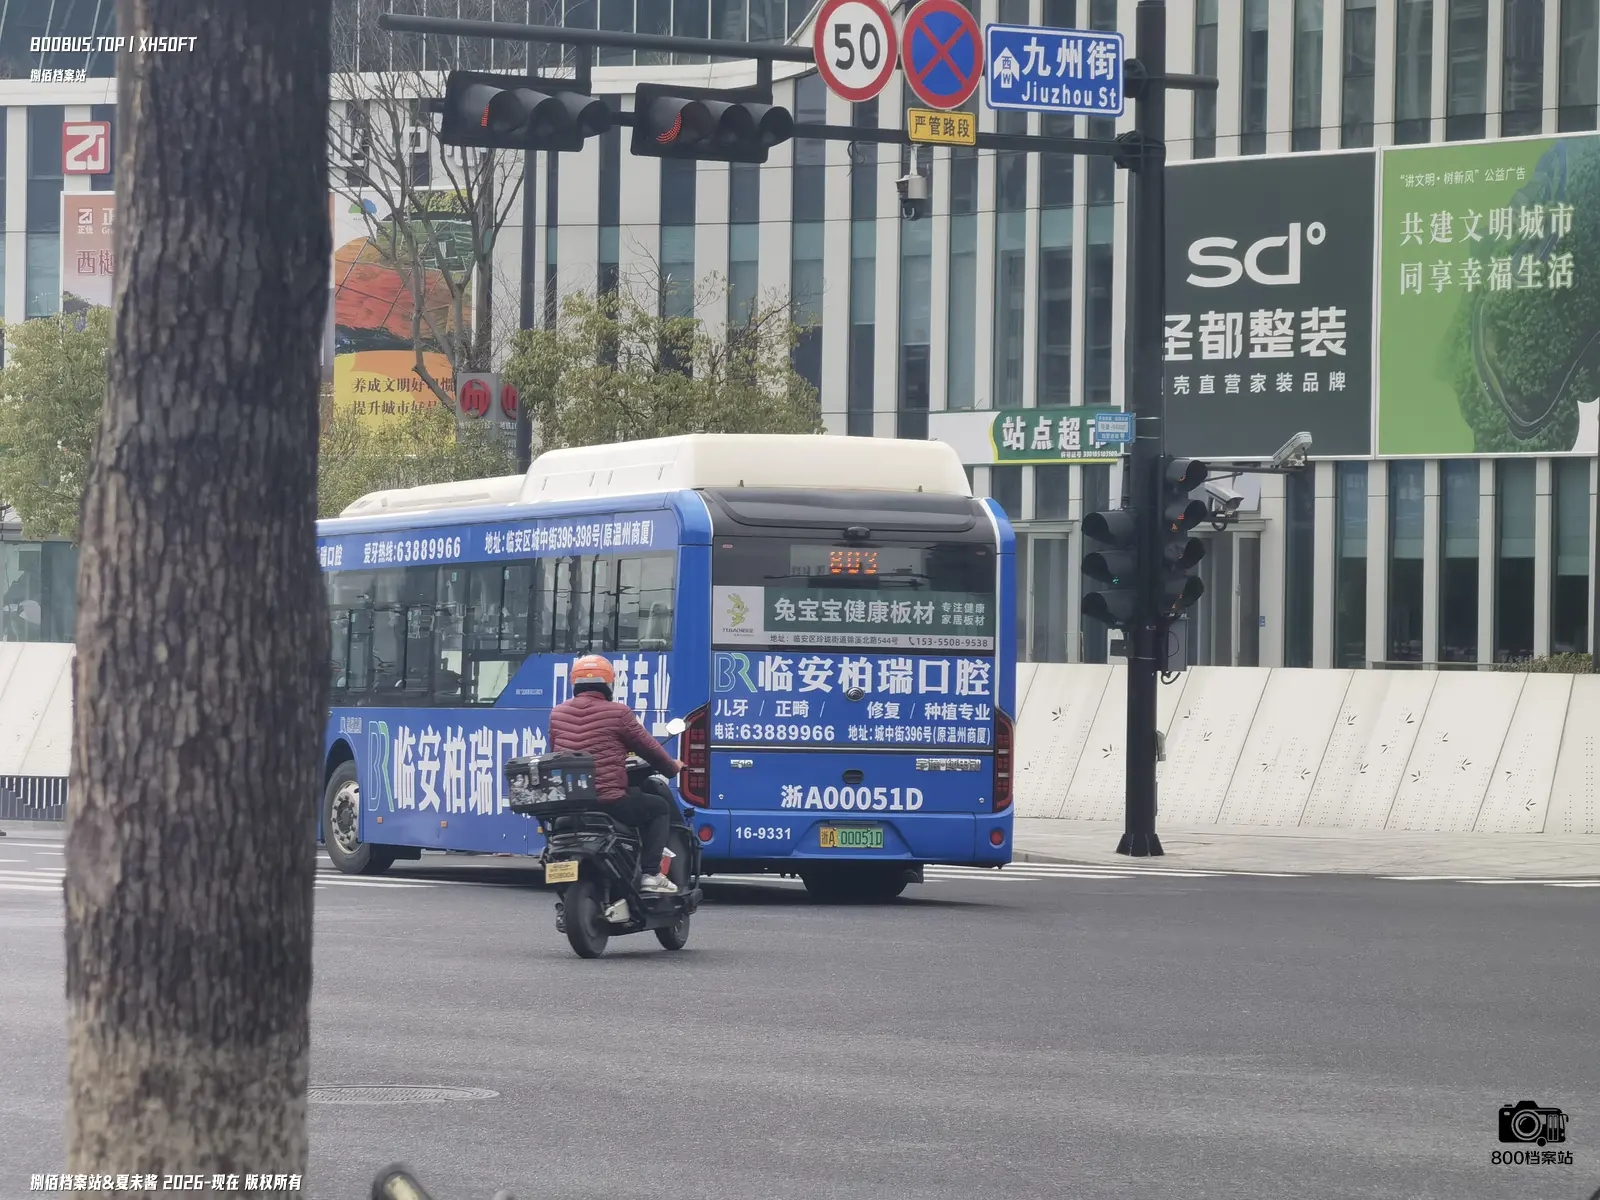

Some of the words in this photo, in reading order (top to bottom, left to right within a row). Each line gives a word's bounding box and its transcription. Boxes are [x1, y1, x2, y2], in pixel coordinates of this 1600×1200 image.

[834, 23, 881, 70] 50
[1021, 37, 1117, 82] 九州街
[1002, 72, 1012, 85] W
[1021, 86, 1093, 107] Jiuzhou
[1098, 87, 1117, 108] St
[914, 115, 970, 139] 严管路段
[1484, 166, 1526, 182] 公益广告
[1399, 202, 1575, 246] 共建文明城市
[1399, 252, 1575, 296] 同享幸福生活
[1162, 306, 1347, 361] 圣都整装
[1161, 371, 1347, 396] 壳直营家装品牌
[830, 551, 878, 574] 803
[774, 597, 935, 625] 兔宝宝健康板材
[941, 602, 985, 613] 专注健康
[941, 614, 985, 626] 家居板材
[916, 637, 988, 648] 153-5508-9538
[758, 655, 991, 696] 临安柏瑞口腔
[714, 700, 749, 717] 儿牙
[775, 700, 809, 718] 正畸
[867, 702, 900, 720] 修复
[924, 702, 990, 721] 种植专业
[714, 723, 835, 741] 电话:63889966
[781, 784, 924, 810] 浙A00051D
[735, 827, 791, 840] 16-9331
